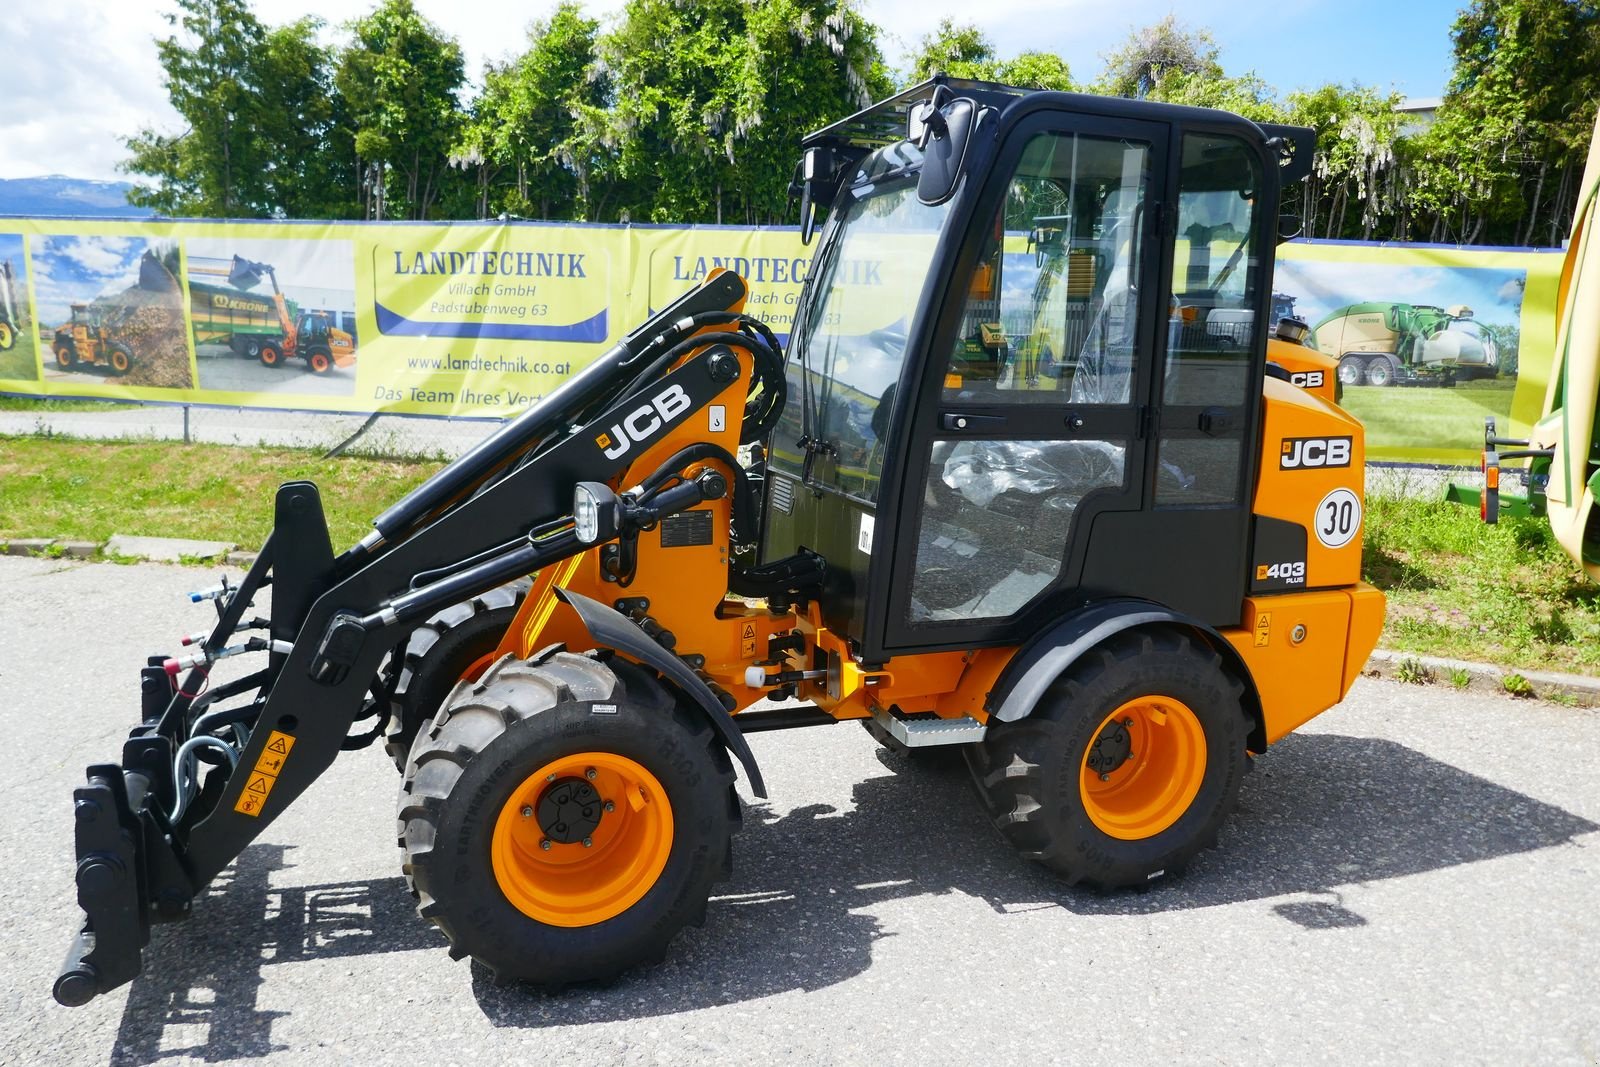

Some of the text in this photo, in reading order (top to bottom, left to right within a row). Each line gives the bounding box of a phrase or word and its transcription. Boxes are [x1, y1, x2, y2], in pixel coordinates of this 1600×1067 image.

[394, 251, 587, 278] LANDTECHNIK
[448, 283, 536, 297] Villach GmbH
[229, 300, 269, 313] KRONE
[430, 301, 548, 319] Badstubenweg 63
[824, 313, 841, 325] 63
[407, 353, 571, 375] www.landtechnik.co.at
[1291, 372, 1323, 388] CB
[374, 386, 403, 401] Das
[409, 387, 455, 404] Team
[460, 388, 501, 405] Ihres
[603, 384, 692, 461] JCB
[1281, 439, 1351, 468] JCB
[1323, 500, 1353, 536] 30
[1267, 562, 1305, 579] 403
[456, 760, 513, 856] EARTHMOVER
